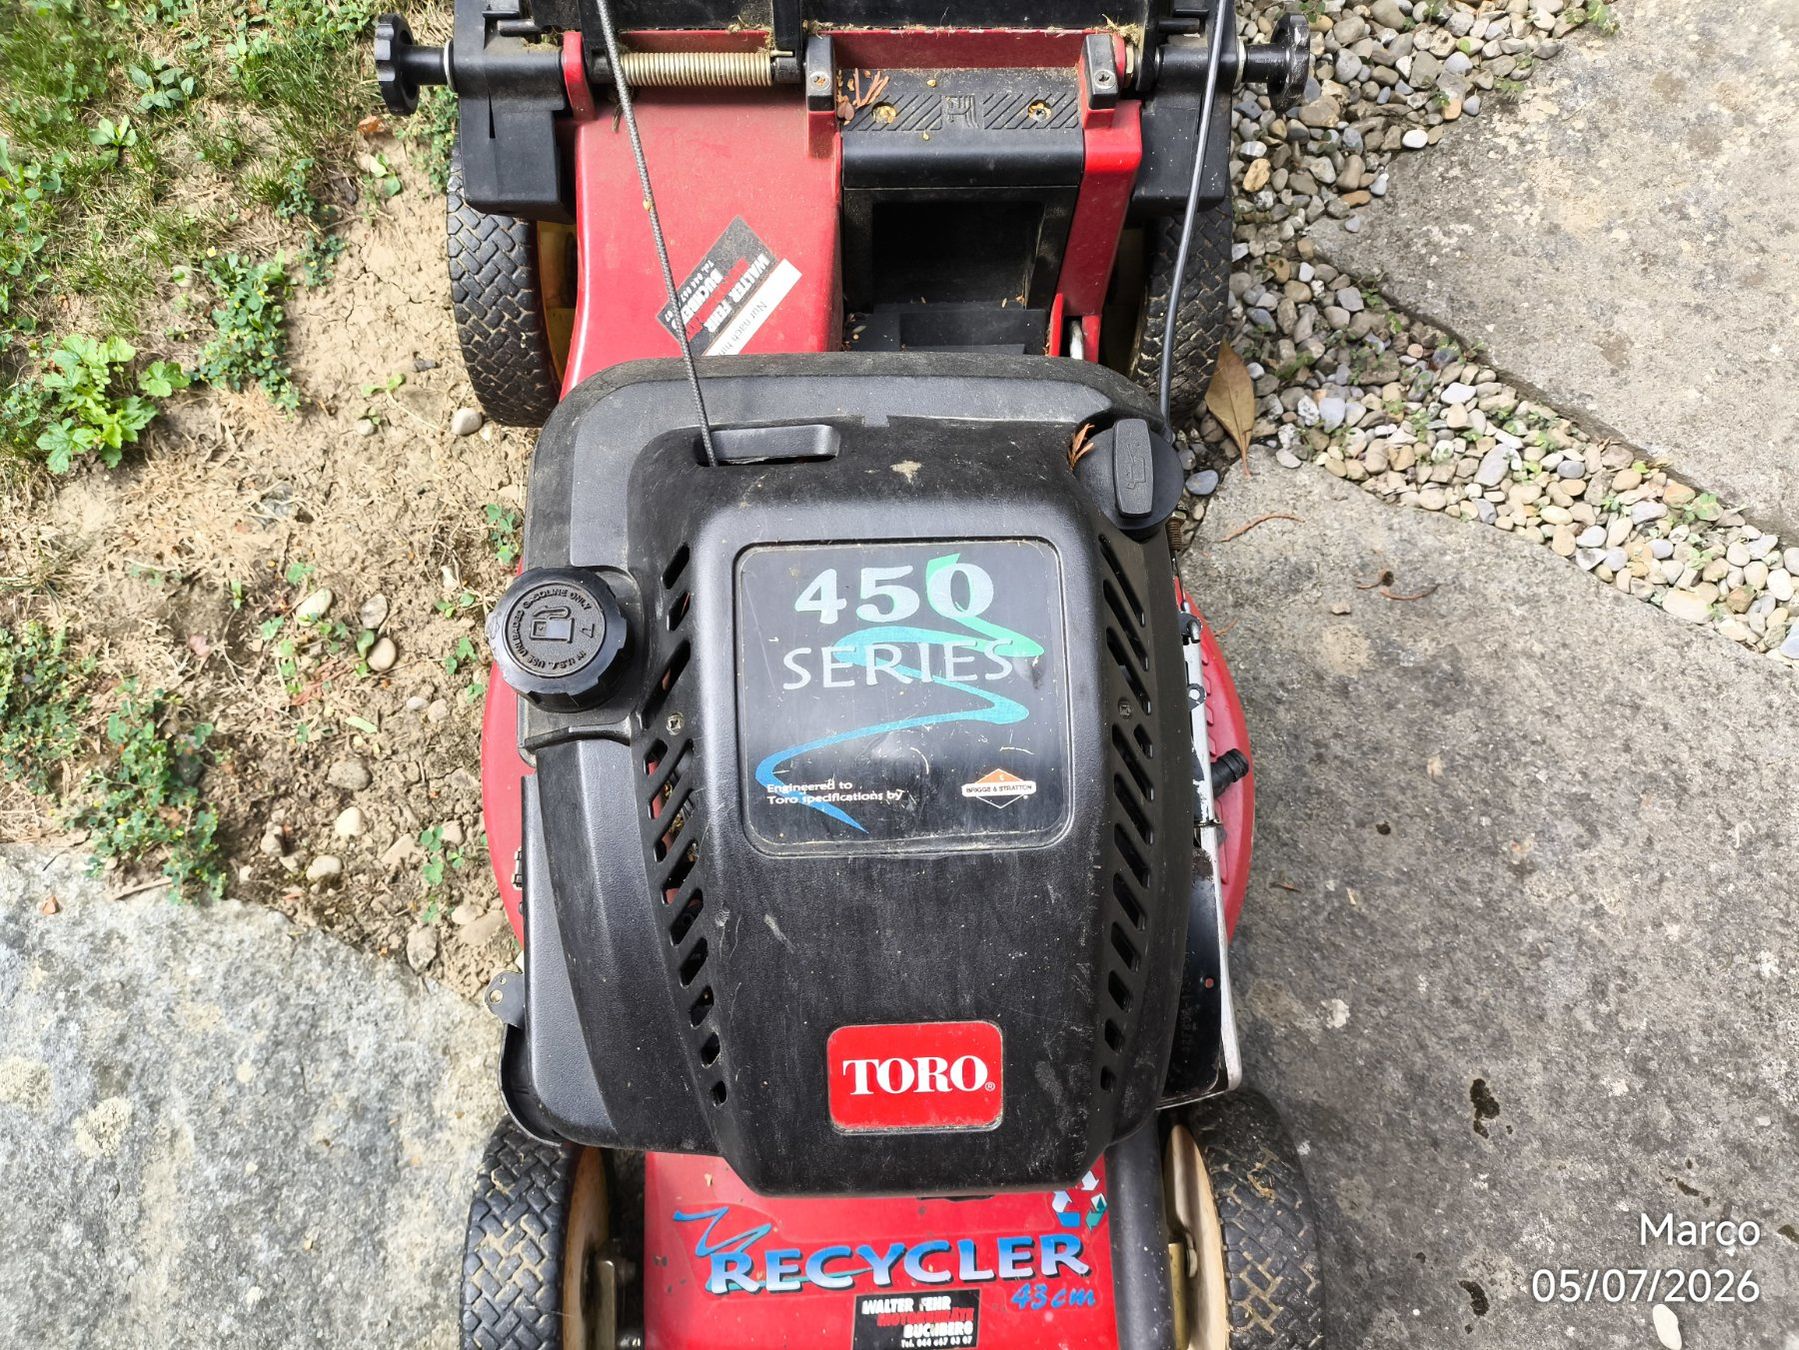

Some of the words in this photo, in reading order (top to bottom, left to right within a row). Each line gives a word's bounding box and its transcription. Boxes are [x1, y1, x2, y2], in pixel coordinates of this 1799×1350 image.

[728, 253, 770, 302] WALTER
[703, 299, 733, 332] FEHR
[794, 562, 994, 624] 450
[783, 639, 1014, 690] SERIES
[767, 781, 835, 794] Engineered
[839, 781, 853, 789] to
[767, 795, 799, 804] Toro
[802, 790, 883, 804] specifications
[887, 789, 904, 801] by
[843, 1055, 988, 1095] TORO
[709, 1233, 1091, 1295] RECYCLER
[861, 1297, 914, 1314] WALTER
[1010, 1284, 1047, 1309] 43
[1051, 1287, 1096, 1307] cm
